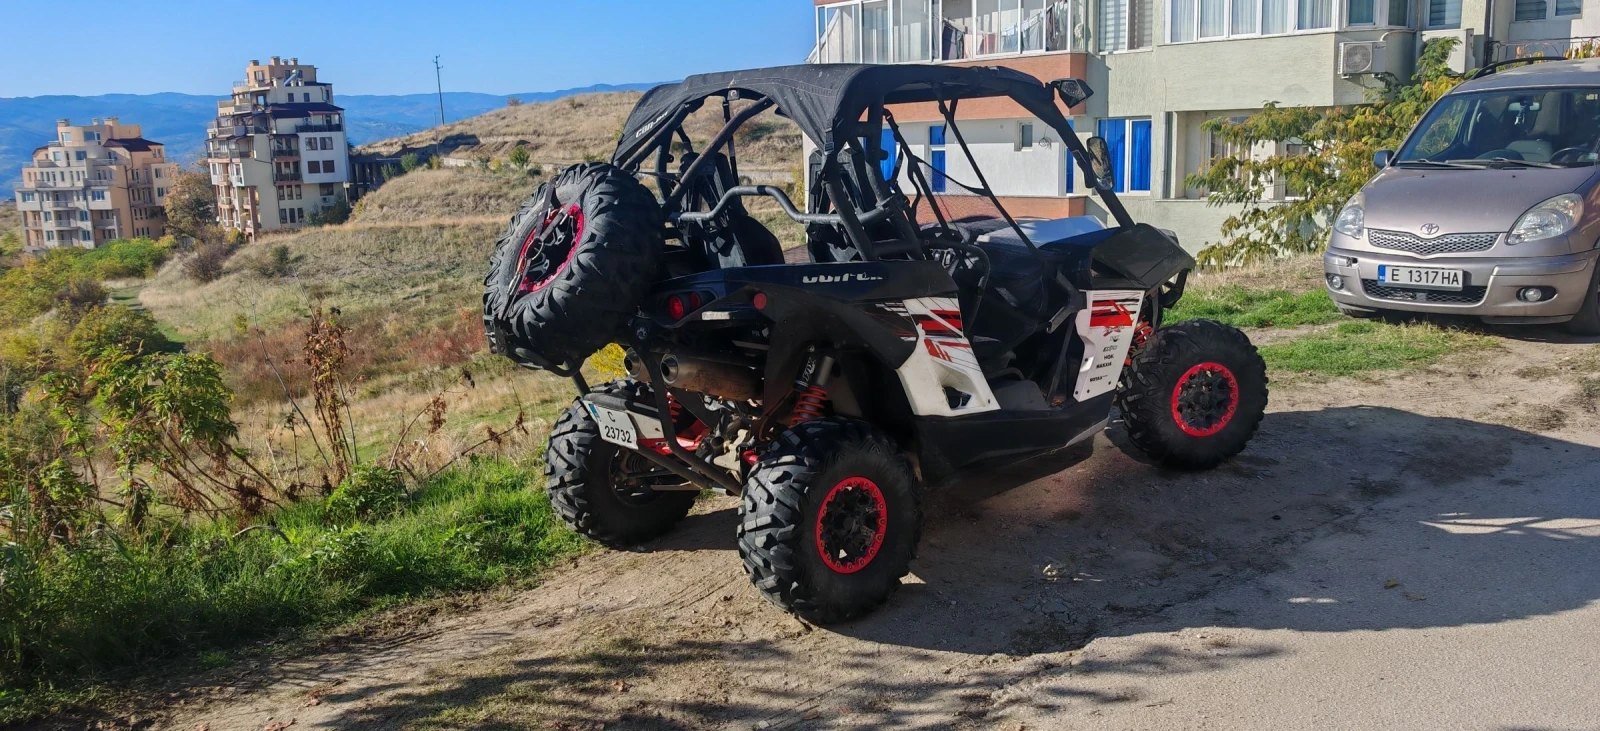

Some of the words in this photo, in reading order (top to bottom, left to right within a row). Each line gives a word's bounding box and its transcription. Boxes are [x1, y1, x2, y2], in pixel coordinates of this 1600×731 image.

[1391, 268, 1400, 282] E
[607, 411, 616, 423] C
[604, 425, 632, 444] 23732
